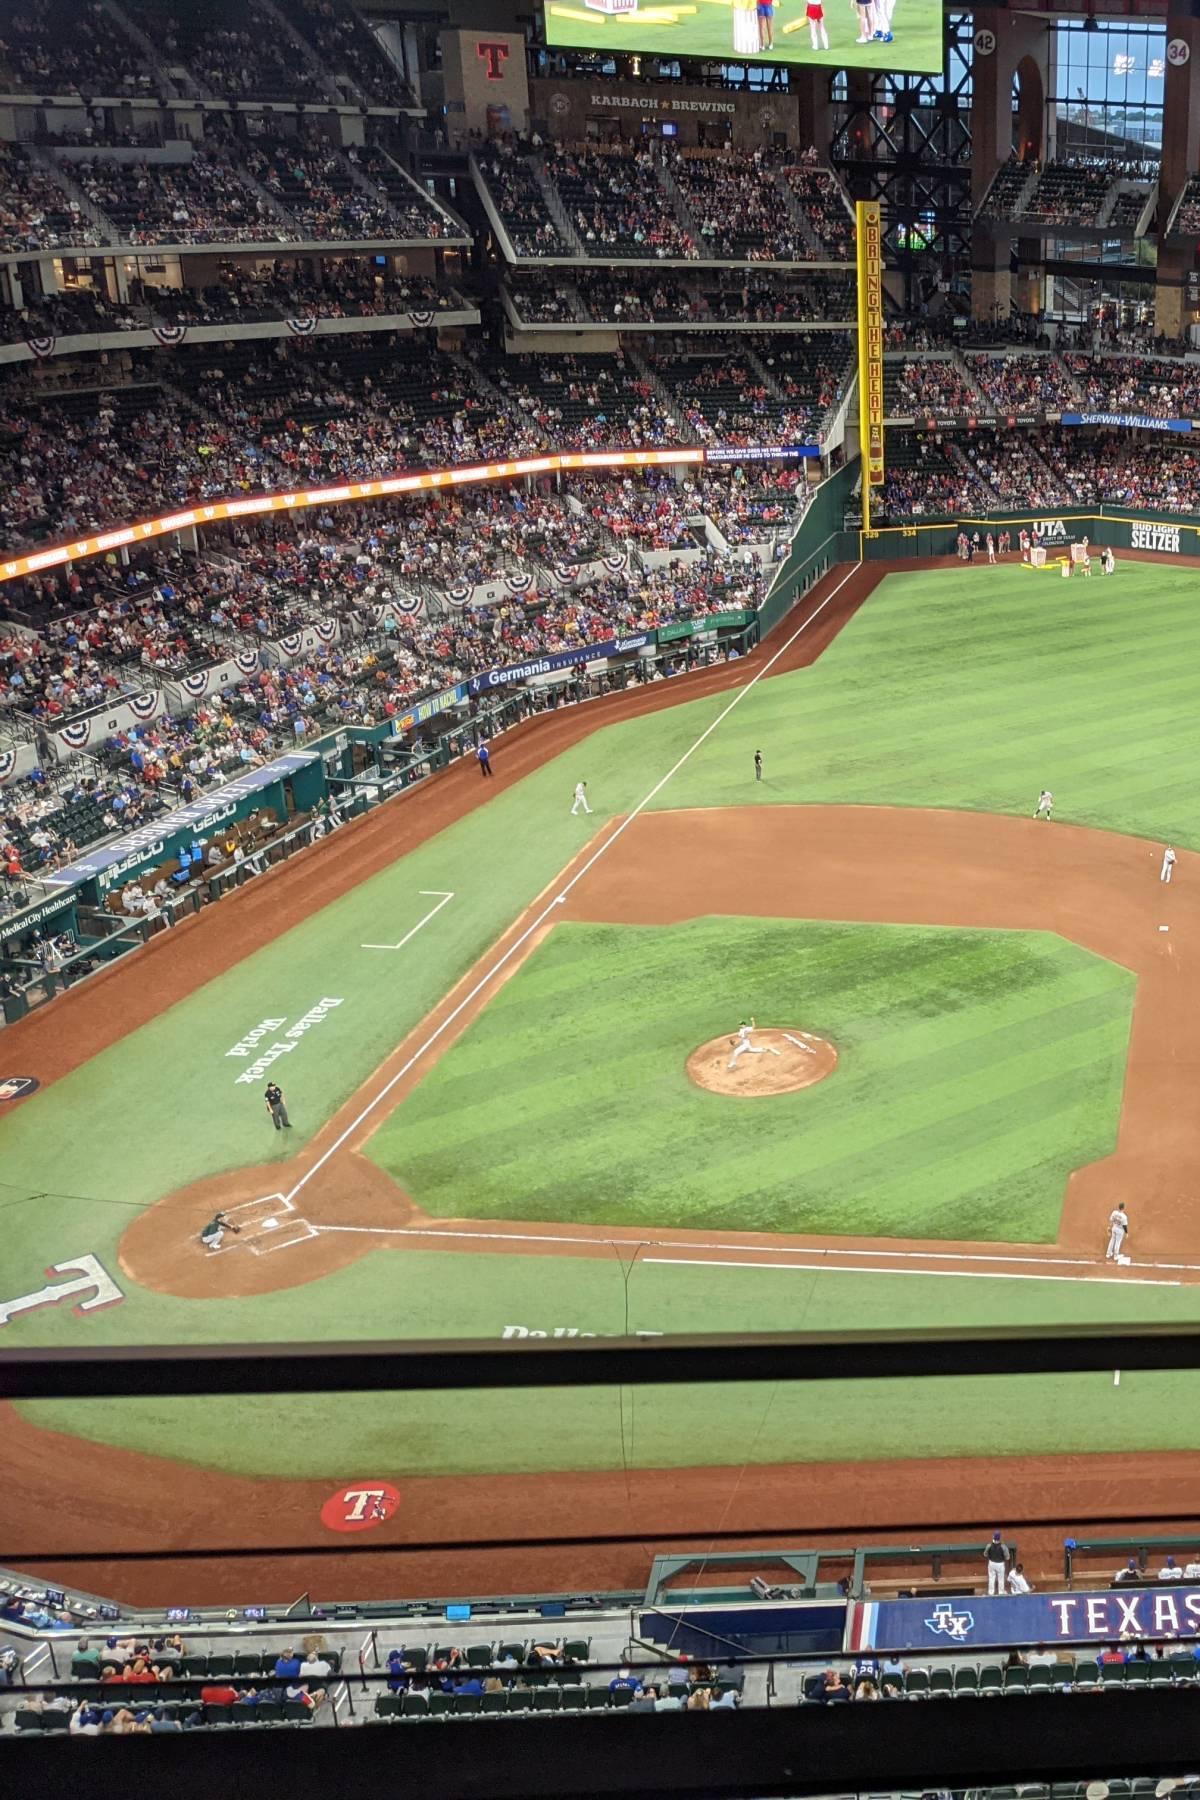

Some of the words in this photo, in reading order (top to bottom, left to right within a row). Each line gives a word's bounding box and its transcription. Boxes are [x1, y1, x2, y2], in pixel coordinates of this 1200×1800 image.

[976, 35, 993, 49] 42
[1169, 45, 1187, 59] 34
[476, 42, 509, 79] T
[591, 95, 658, 109] KARBACH
[672, 100, 735, 113] BREWING
[868, 228, 878, 306] BRING
[869, 313, 879, 357] THE
[870, 363, 880, 423] HEAT
[937, 419, 957, 427] TOYOTA
[977, 418, 997, 426] TOYOTA
[1033, 521, 1066, 537] UTA
[1131, 530, 1180, 552] SELTZER
[1132, 523, 1153, 532] BUD
[1153, 525, 1180, 534] LIGHT
[489, 660, 550, 684] Germania
[552, 652, 601, 667] INSURANCE
[188, 804, 237, 833] GEICO
[113, 841, 164, 875] GEICO
[1, 918, 31, 940] Medical
[28, 912, 41, 925] City
[43, 894, 77, 915] Healthcare
[285, 997, 344, 1038] Dallas
[225, 1017, 287, 1056] World
[235, 1041, 298, 1084] Truck
[859, 1665, 873, 1674] 29
